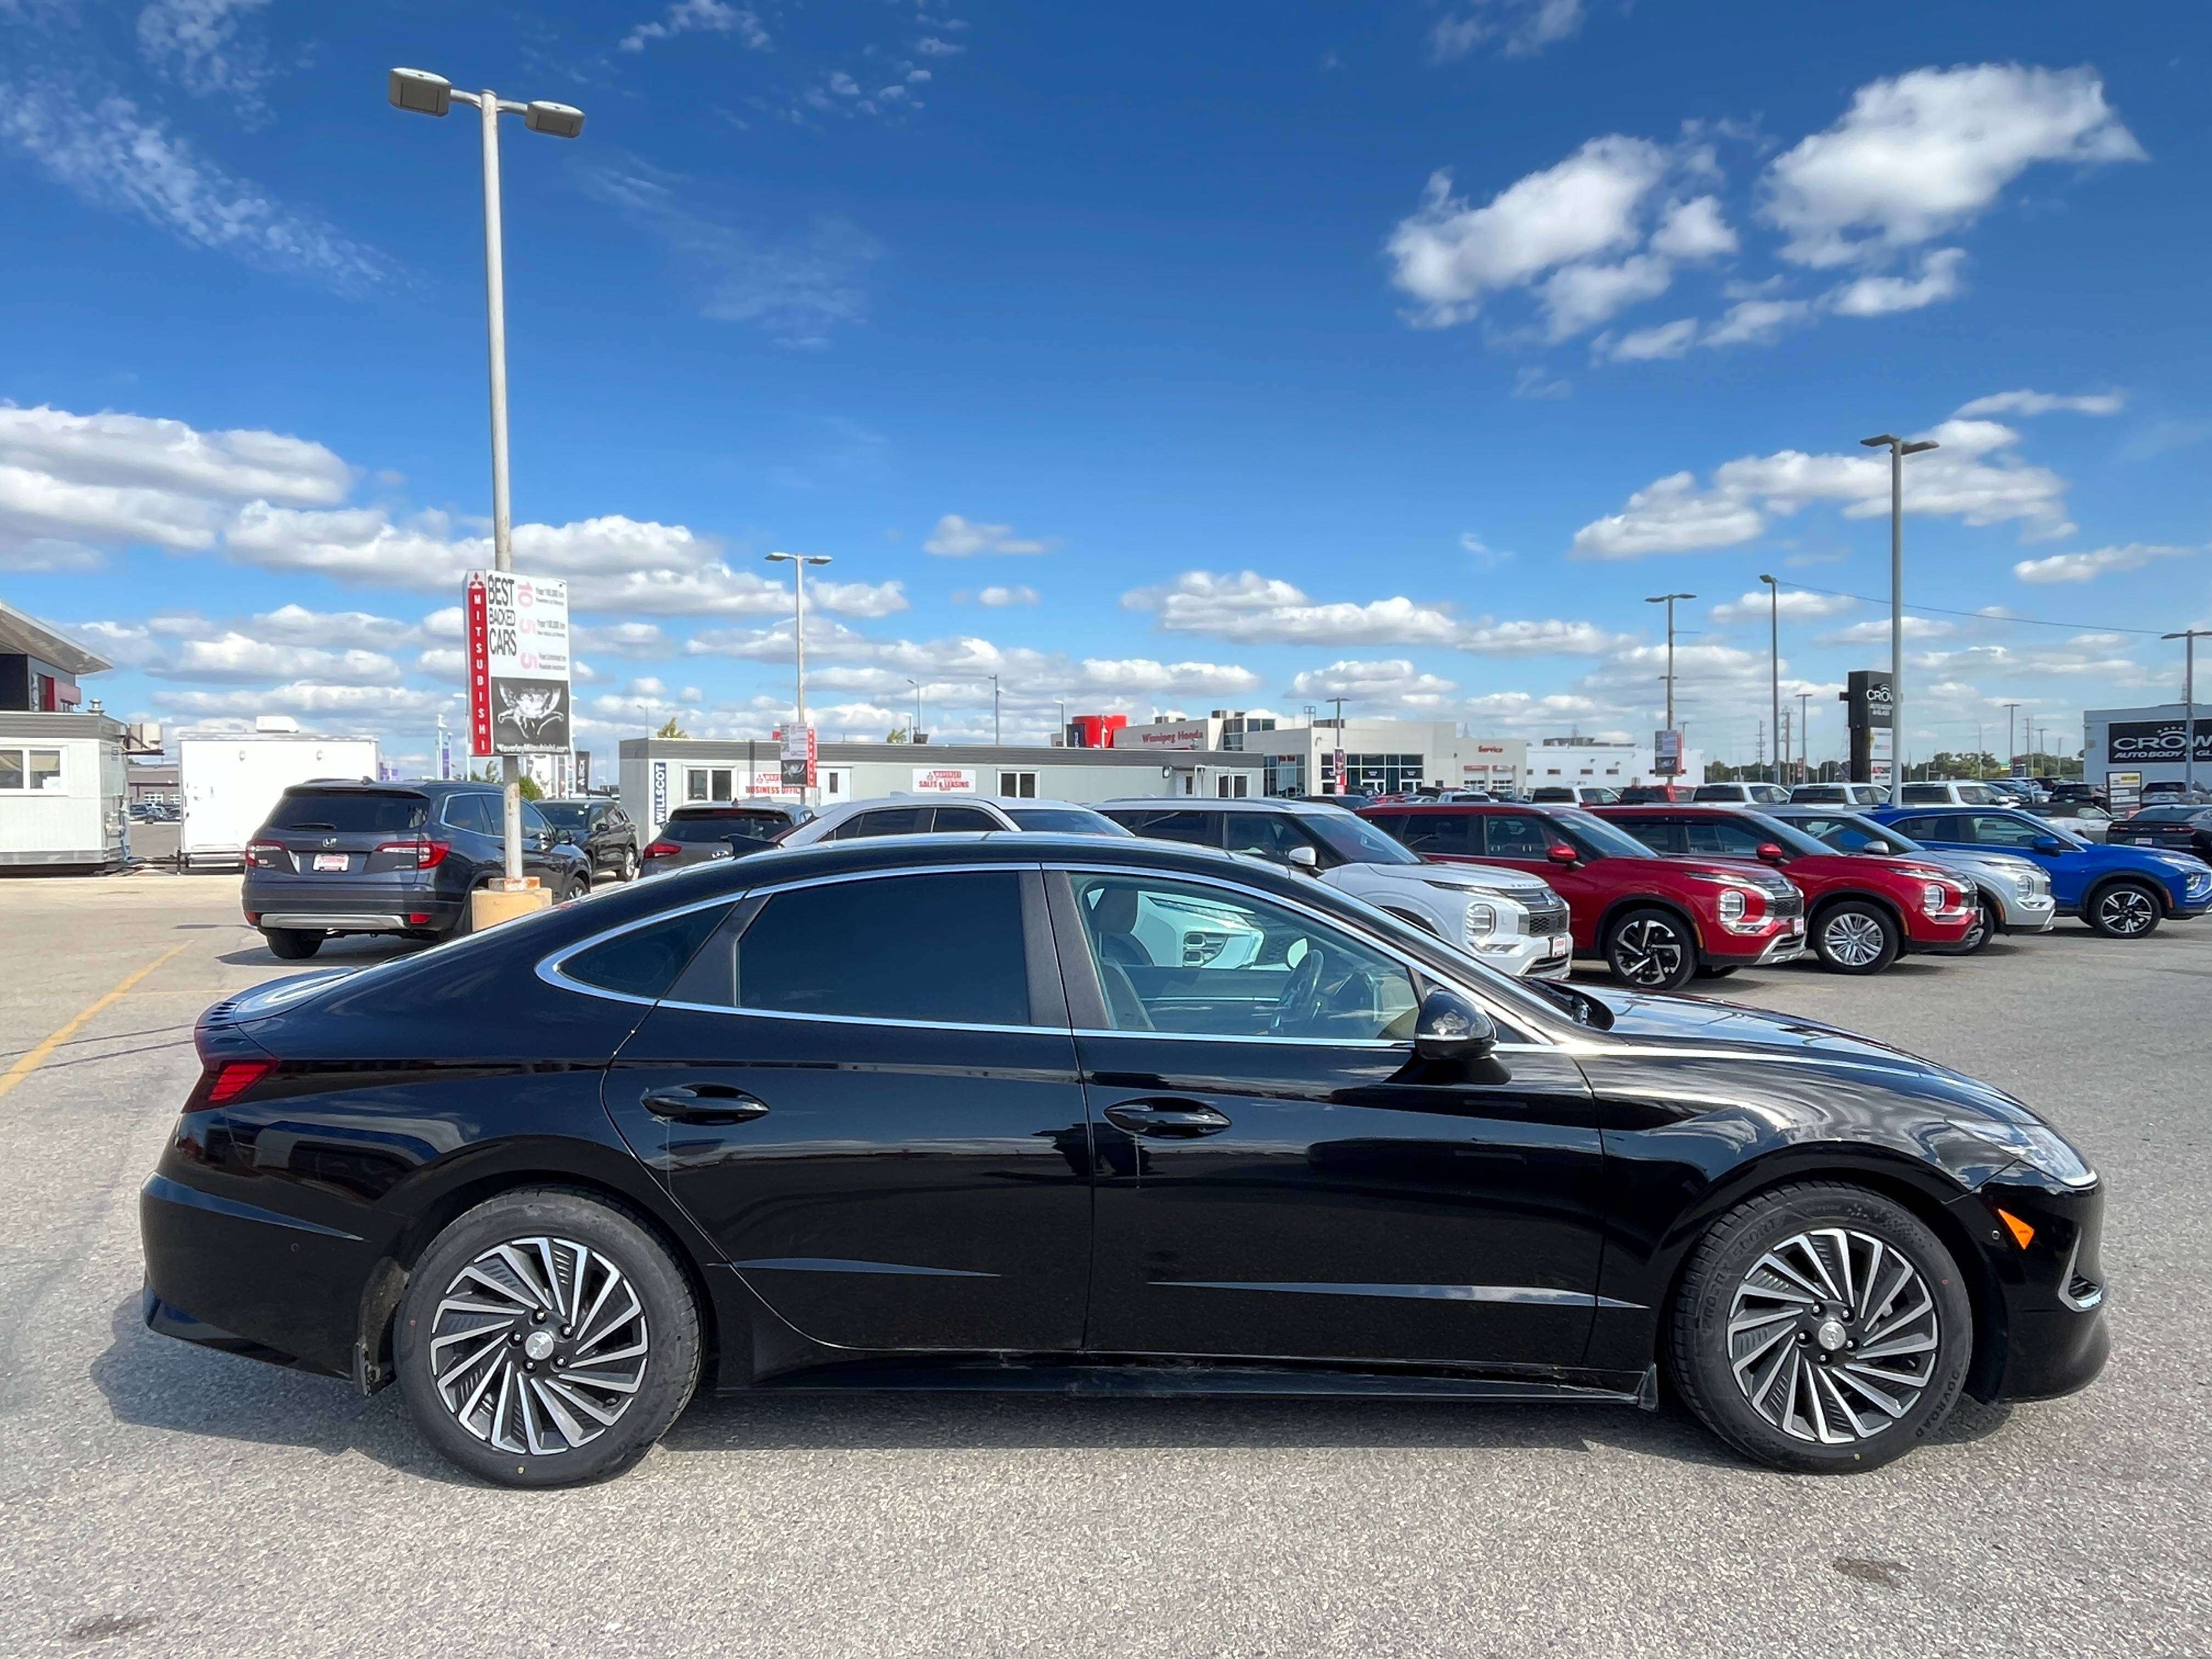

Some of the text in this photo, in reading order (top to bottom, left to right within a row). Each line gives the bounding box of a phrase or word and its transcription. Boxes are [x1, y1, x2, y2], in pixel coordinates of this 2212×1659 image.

[488, 575, 515, 606] BEST
[489, 628, 517, 656] CARS
[473, 594, 486, 751] MITSUBISHI
[1867, 689, 1892, 702] CRO
[1142, 729, 1204, 744] Winnipeg Honda
[655, 765, 665, 823] WILLSCOT
